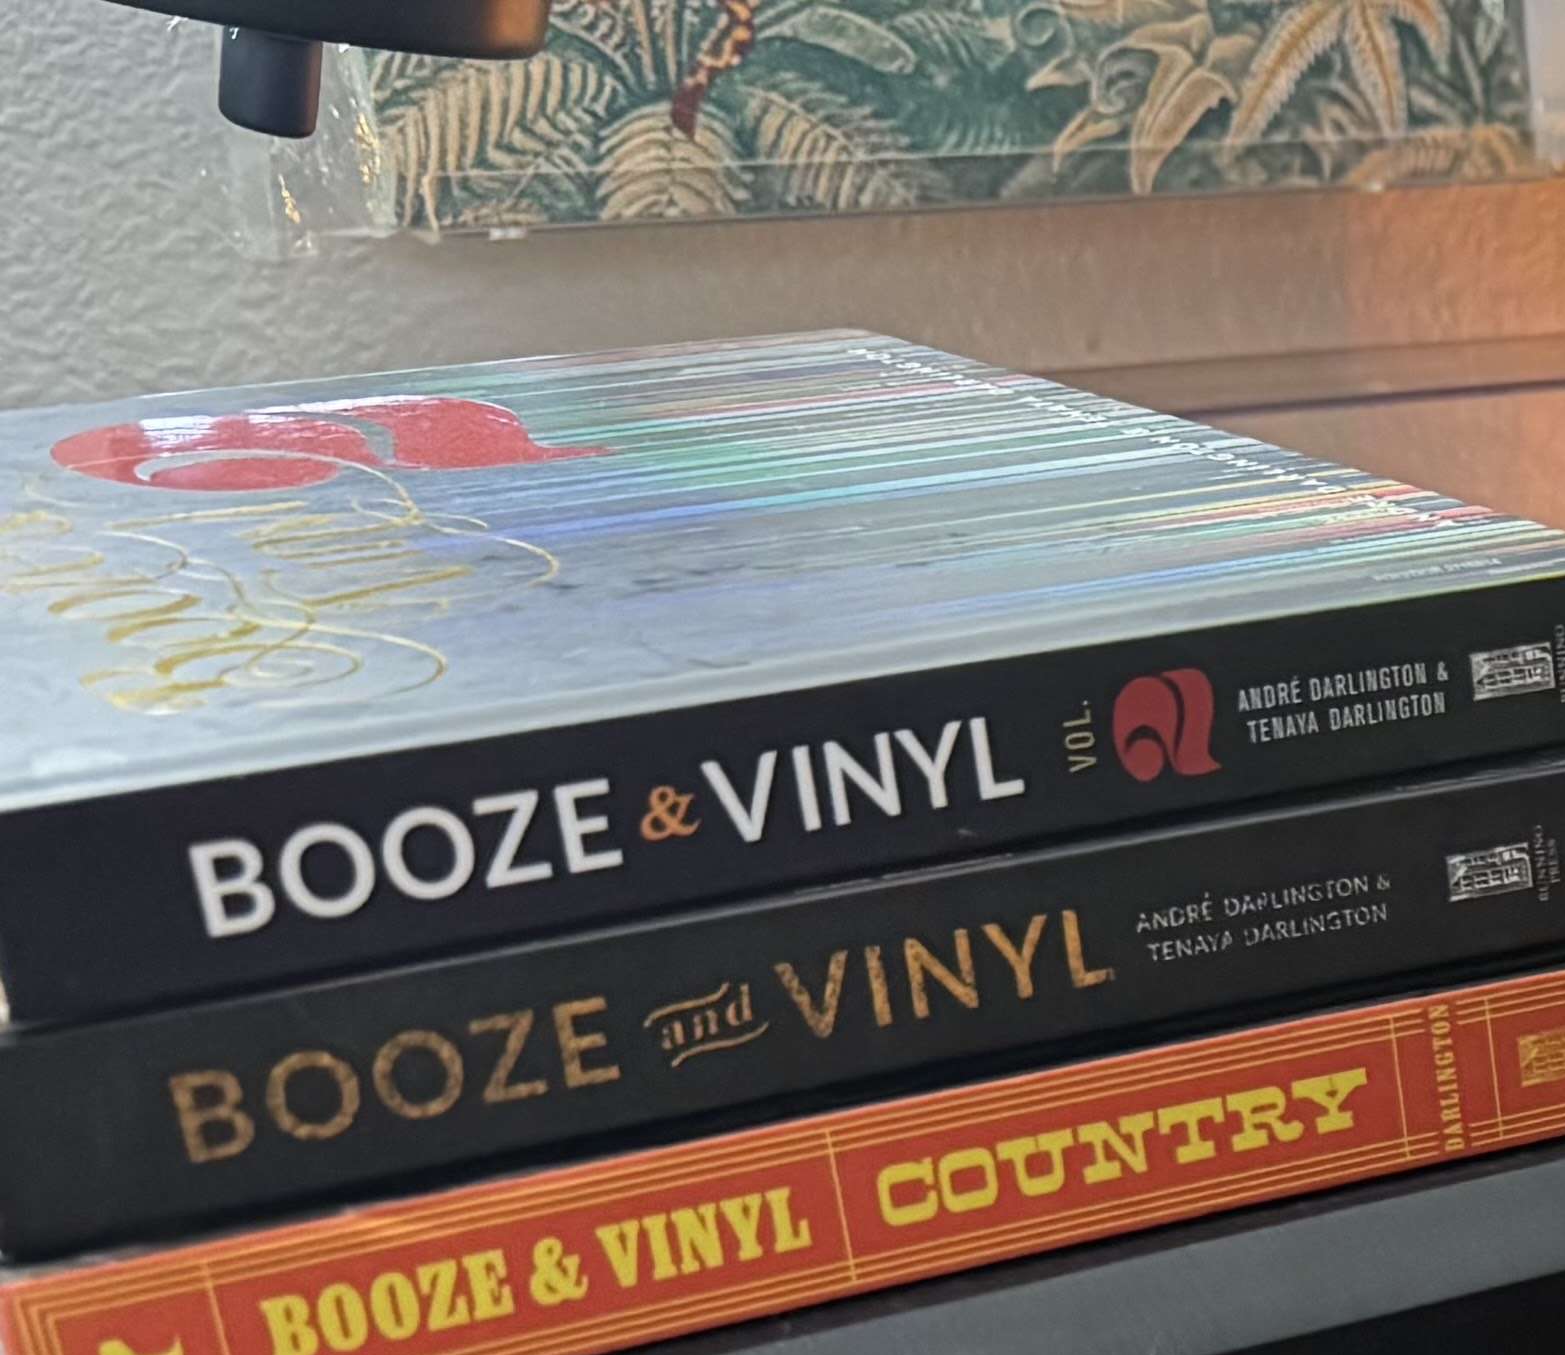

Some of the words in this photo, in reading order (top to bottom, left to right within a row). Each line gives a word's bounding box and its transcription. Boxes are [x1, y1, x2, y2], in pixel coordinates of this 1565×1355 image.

[1237, 672, 1302, 713] ANDRÉ
[1309, 662, 1428, 704] DARLINGTON
[1436, 660, 1449, 682] &
[1246, 712, 1320, 745] TENAYA
[1329, 693, 1446, 731] DARLINGTON
[1062, 699, 1098, 774] VOL.
[188, 778, 624, 939] BOOZE
[639, 785, 701, 841] &
[701, 714, 1026, 844] VINYL
[1136, 889, 1216, 934] ANDRÉ
[1224, 875, 1371, 918] DARLINGTON
[1376, 873, 1391, 893] &
[1146, 930, 1233, 964] TENAYA
[1244, 902, 1389, 948] DARLINGTON
[168, 995, 621, 1164] BOOZE
[656, 982, 764, 1060] and
[773, 909, 1117, 1041] VINYL
[1427, 1002, 1466, 1151] DARLINGTON
[877, 1068, 1368, 1227] COUNTRY
[529, 1236, 588, 1308] &
[595, 1186, 813, 1289] VINYL
